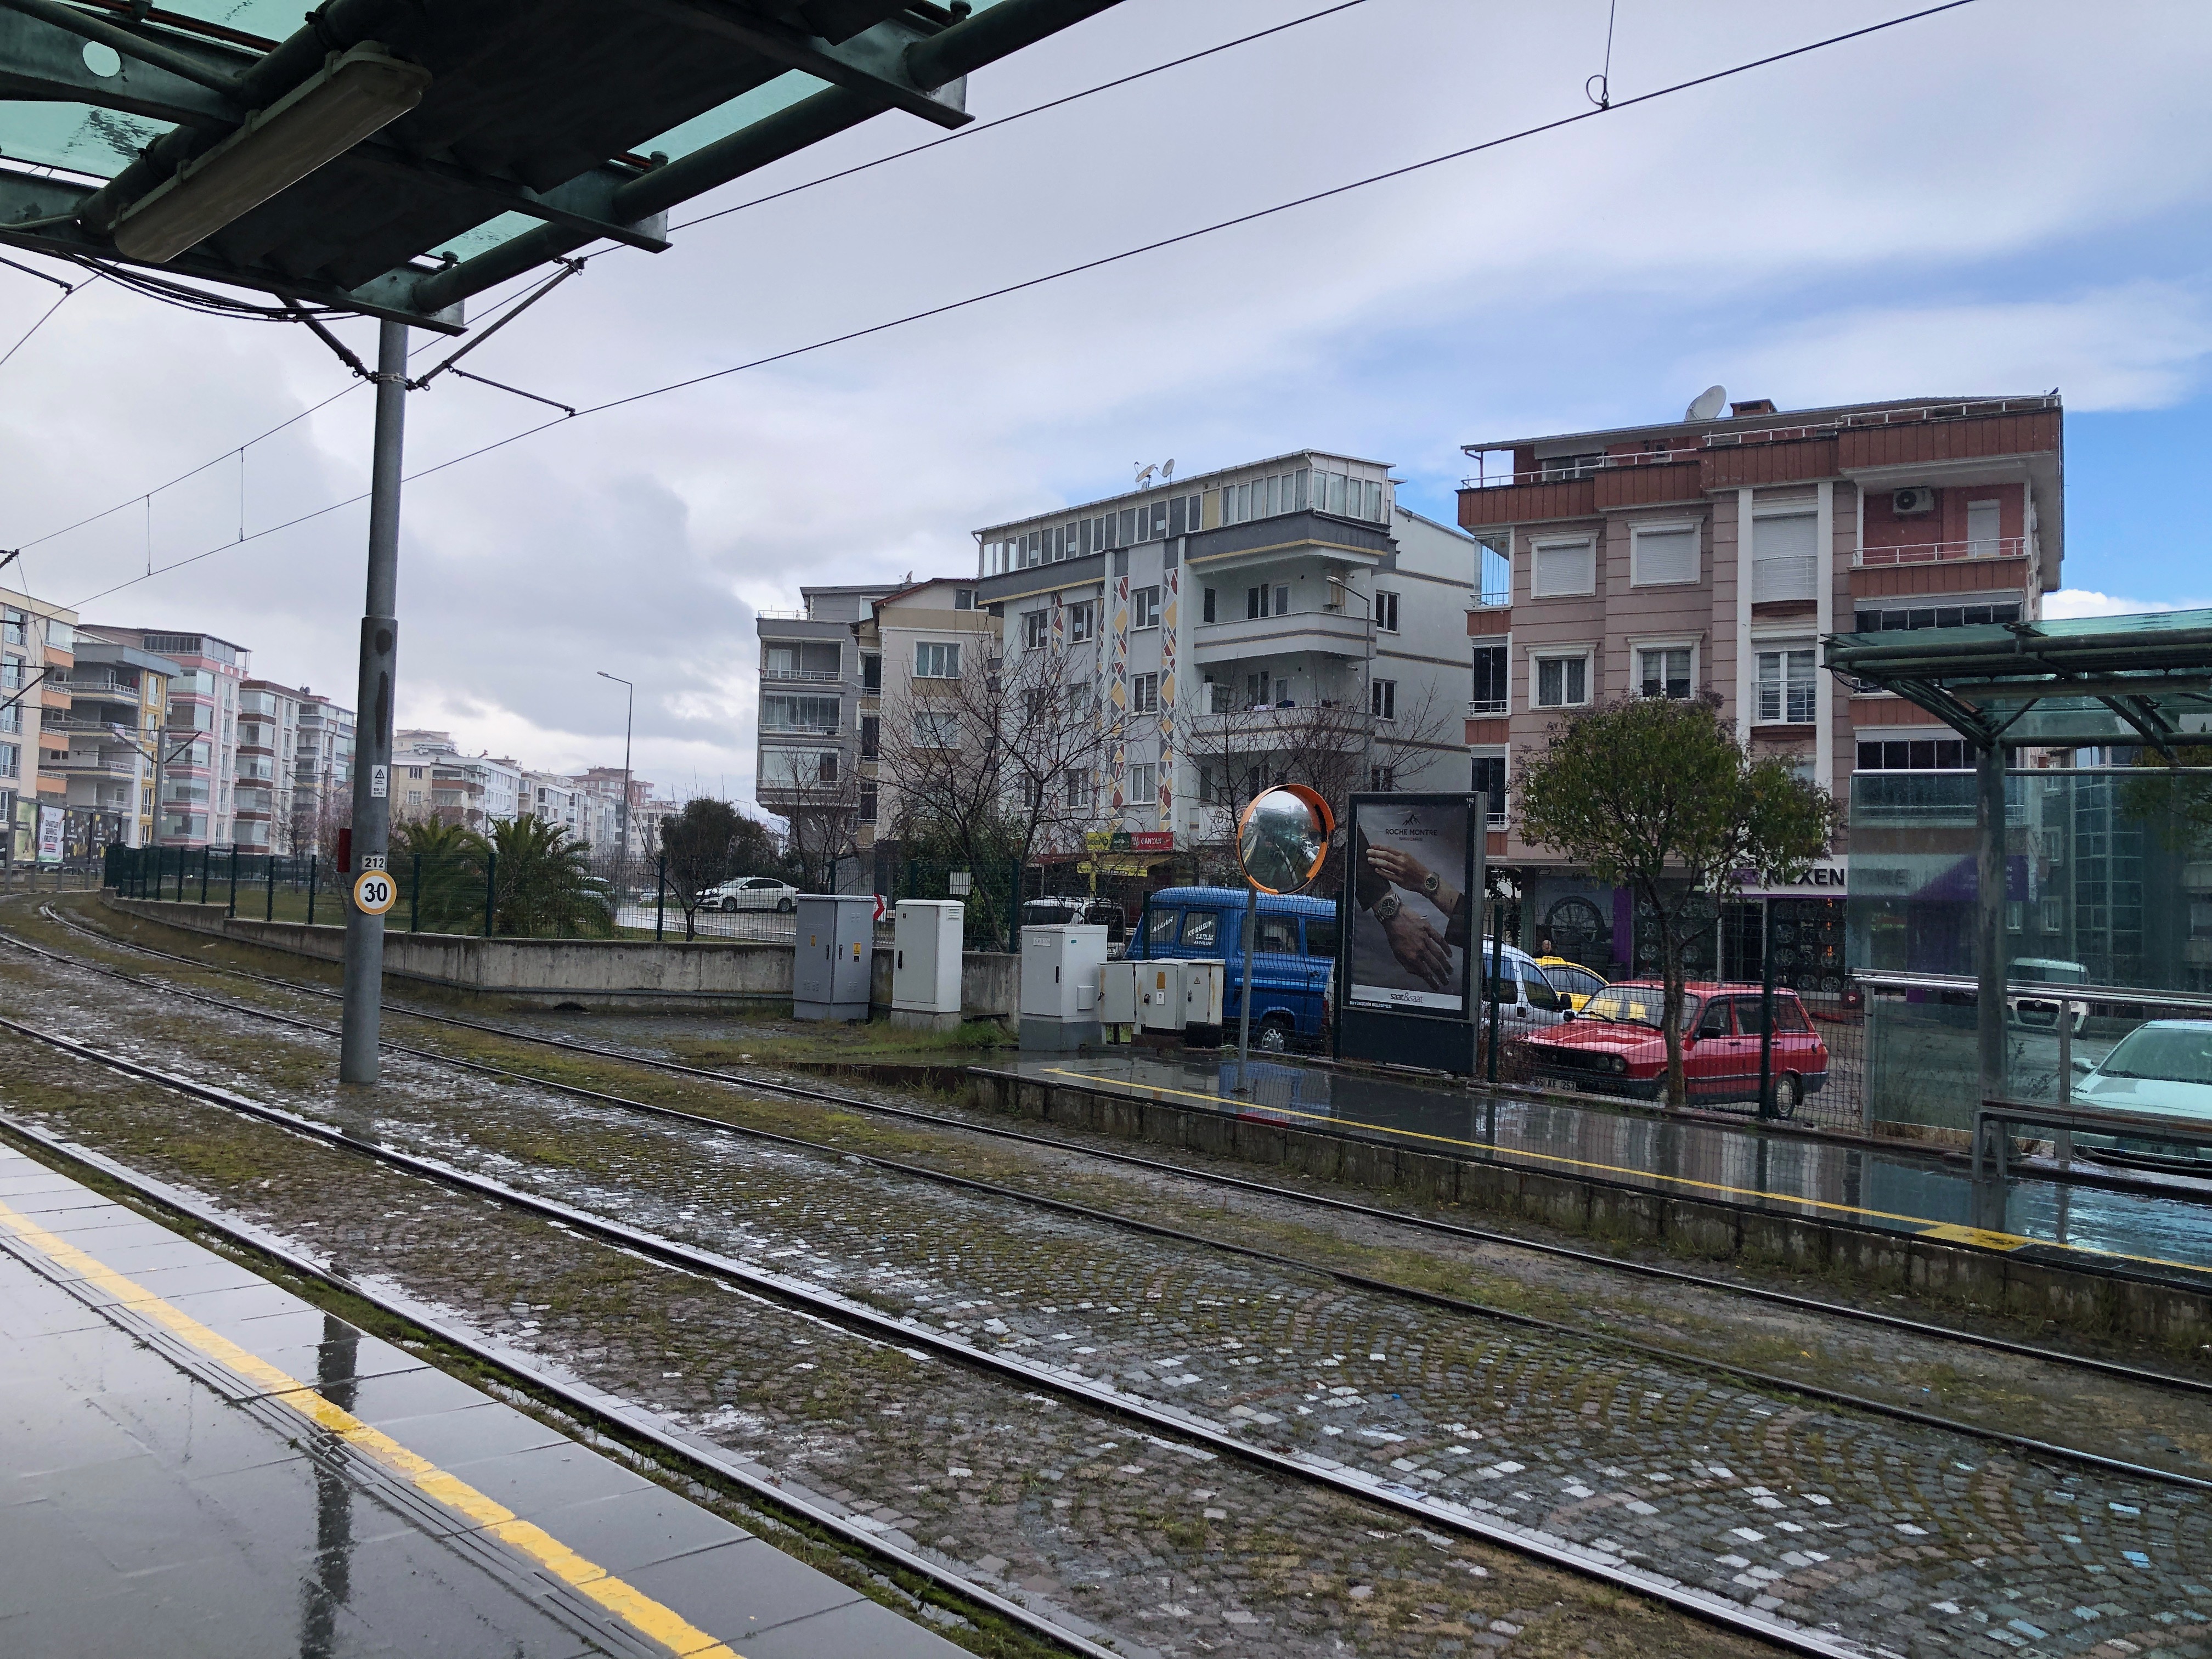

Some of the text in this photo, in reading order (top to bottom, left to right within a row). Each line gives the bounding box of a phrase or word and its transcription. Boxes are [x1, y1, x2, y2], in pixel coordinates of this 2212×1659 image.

[365, 857, 384, 868] 212
[1767, 868, 1845, 885] NXEN
[364, 882, 387, 902] 30
[1390, 992, 1423, 1003] saat&saat
